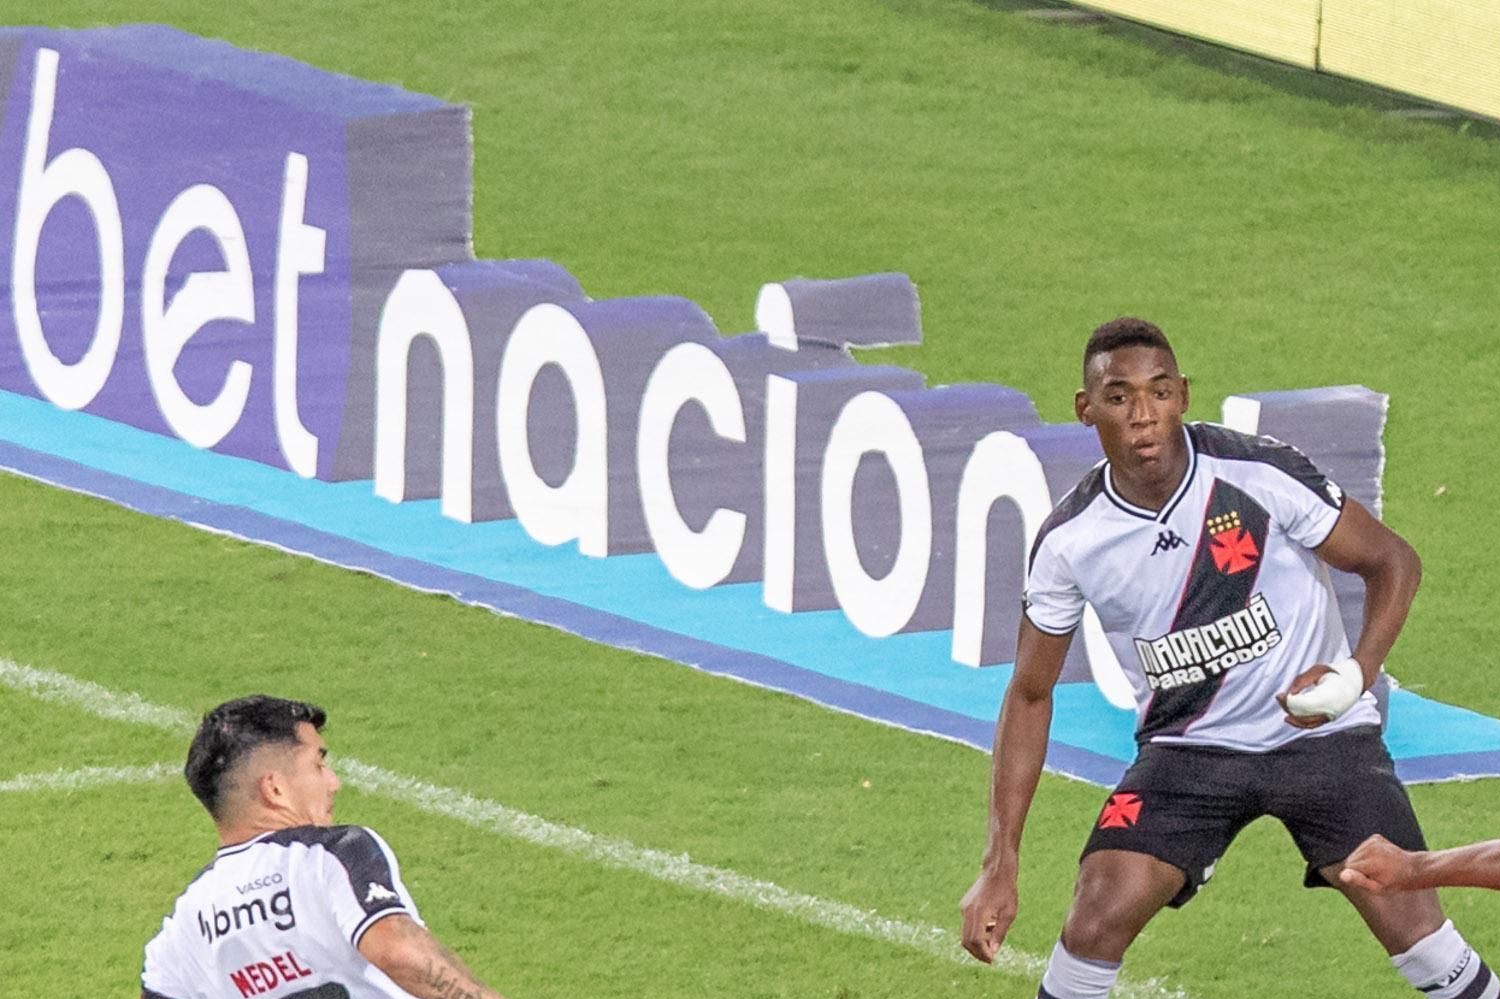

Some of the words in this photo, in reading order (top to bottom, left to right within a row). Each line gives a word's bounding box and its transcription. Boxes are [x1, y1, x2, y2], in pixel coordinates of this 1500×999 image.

[12, 47, 326, 480] bet
[373, 268, 1261, 712] nacion
[1206, 630, 1282, 675] TODOS
[236, 872, 284, 896] VASCO
[212, 886, 296, 939] bmg
[229, 951, 313, 999] MEDEL
